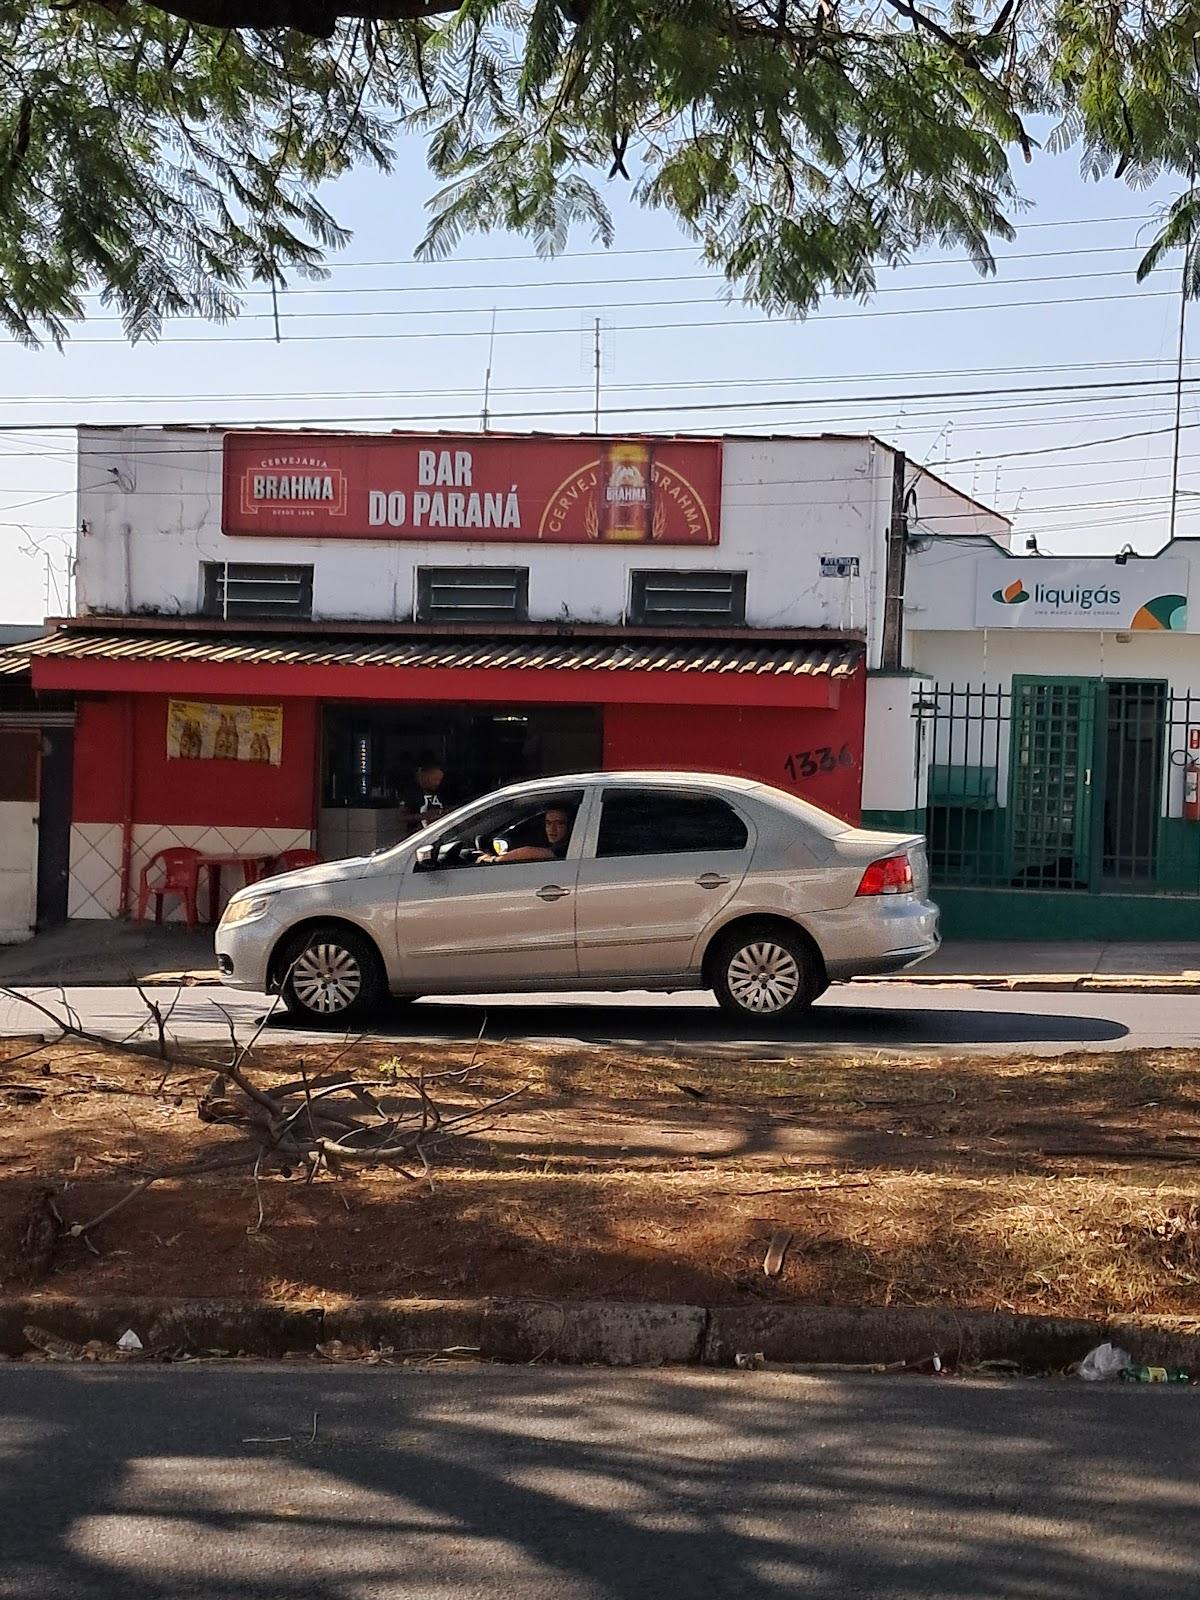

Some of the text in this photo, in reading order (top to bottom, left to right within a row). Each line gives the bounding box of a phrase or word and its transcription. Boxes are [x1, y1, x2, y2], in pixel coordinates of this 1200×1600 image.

[261, 457, 328, 468] CERVEJARIA
[418, 450, 472, 487] BAR
[253, 474, 334, 500] BRAHMA
[606, 487, 647, 502] BRAHMA
[368, 484, 521, 529] DO PARANÁ
[549, 472, 598, 533] CERVEJ
[1035, 583, 1120, 609] liquigás
